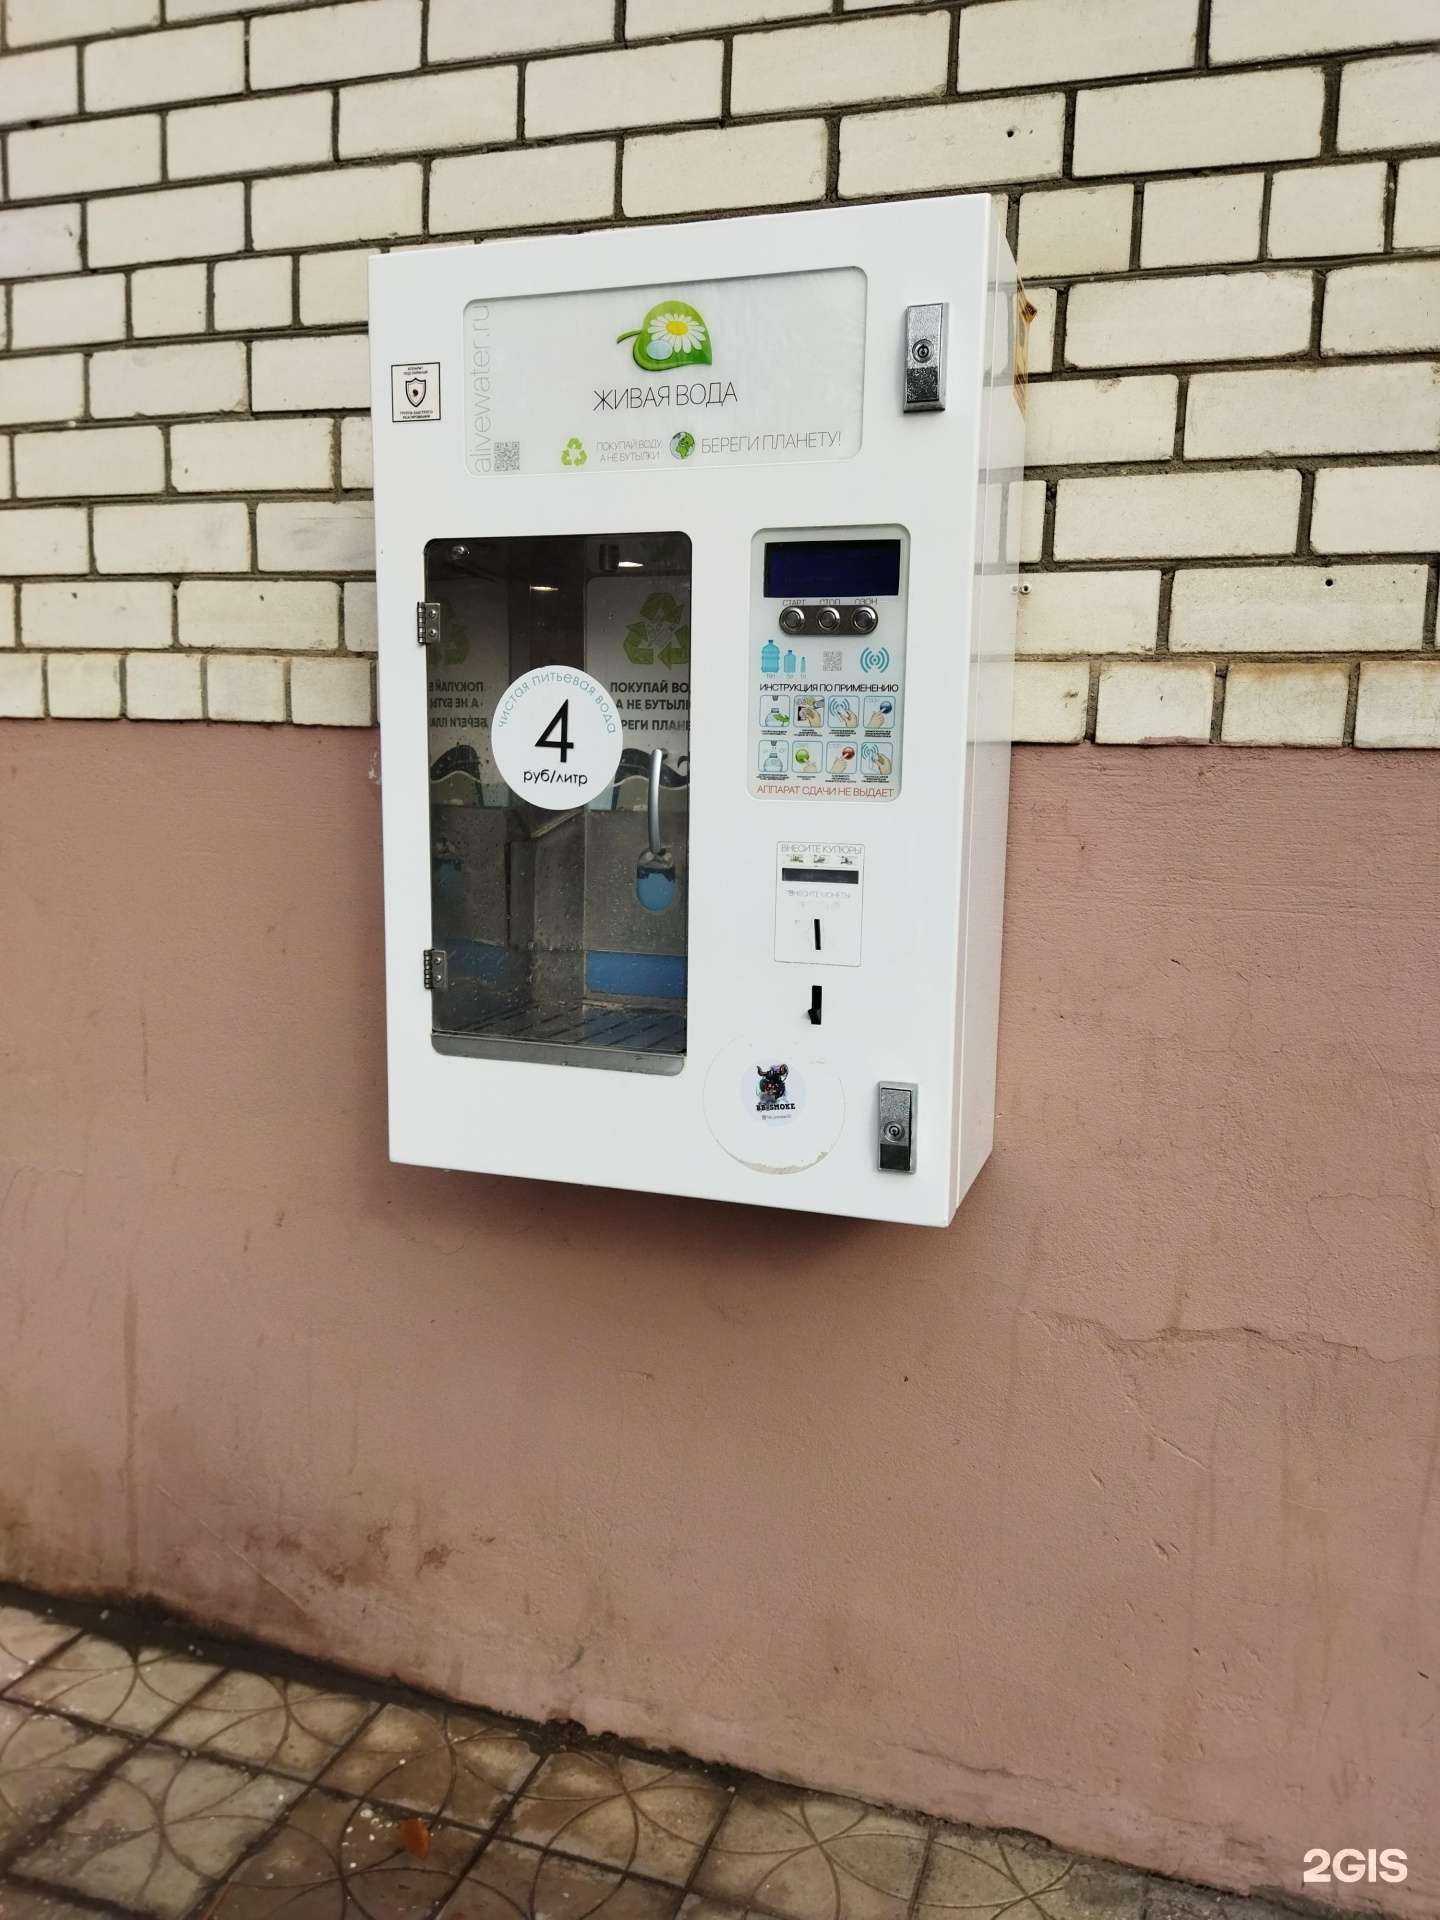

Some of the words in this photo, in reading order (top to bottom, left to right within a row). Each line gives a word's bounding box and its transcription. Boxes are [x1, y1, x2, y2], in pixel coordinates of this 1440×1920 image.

[469, 304, 492, 473] alivewater.ru
[593, 385, 671, 412] ЖИВАЯ
[676, 381, 738, 407] ВОДА
[701, 435, 759, 454] БЕРЕГИ
[762, 431, 841, 450] ПЛАНЕТУ!
[610, 679, 668, 693] ПОКУПАЙ
[759, 683, 818, 693] ИНСТРУКЦИЯ
[819, 684, 833, 692] ПО
[834, 684, 899, 693] ПРИМЕНЕНИЮ
[498, 682, 529, 728] чистая
[531, 672, 597, 696] питьевая
[595, 695, 617, 734] вода
[616, 699, 624, 709] А
[626, 699, 642, 710] НЕ
[534, 698, 574, 763] 4
[621, 720, 649, 730] РЕГИ
[523, 769, 588, 787] руб/литр
[757, 784, 801, 794] АППАРАТ
[801, 785, 837, 796] СДАЧИ
[838, 786, 851, 795] НЕ
[853, 787, 895, 798] ВЫДАЕТ
